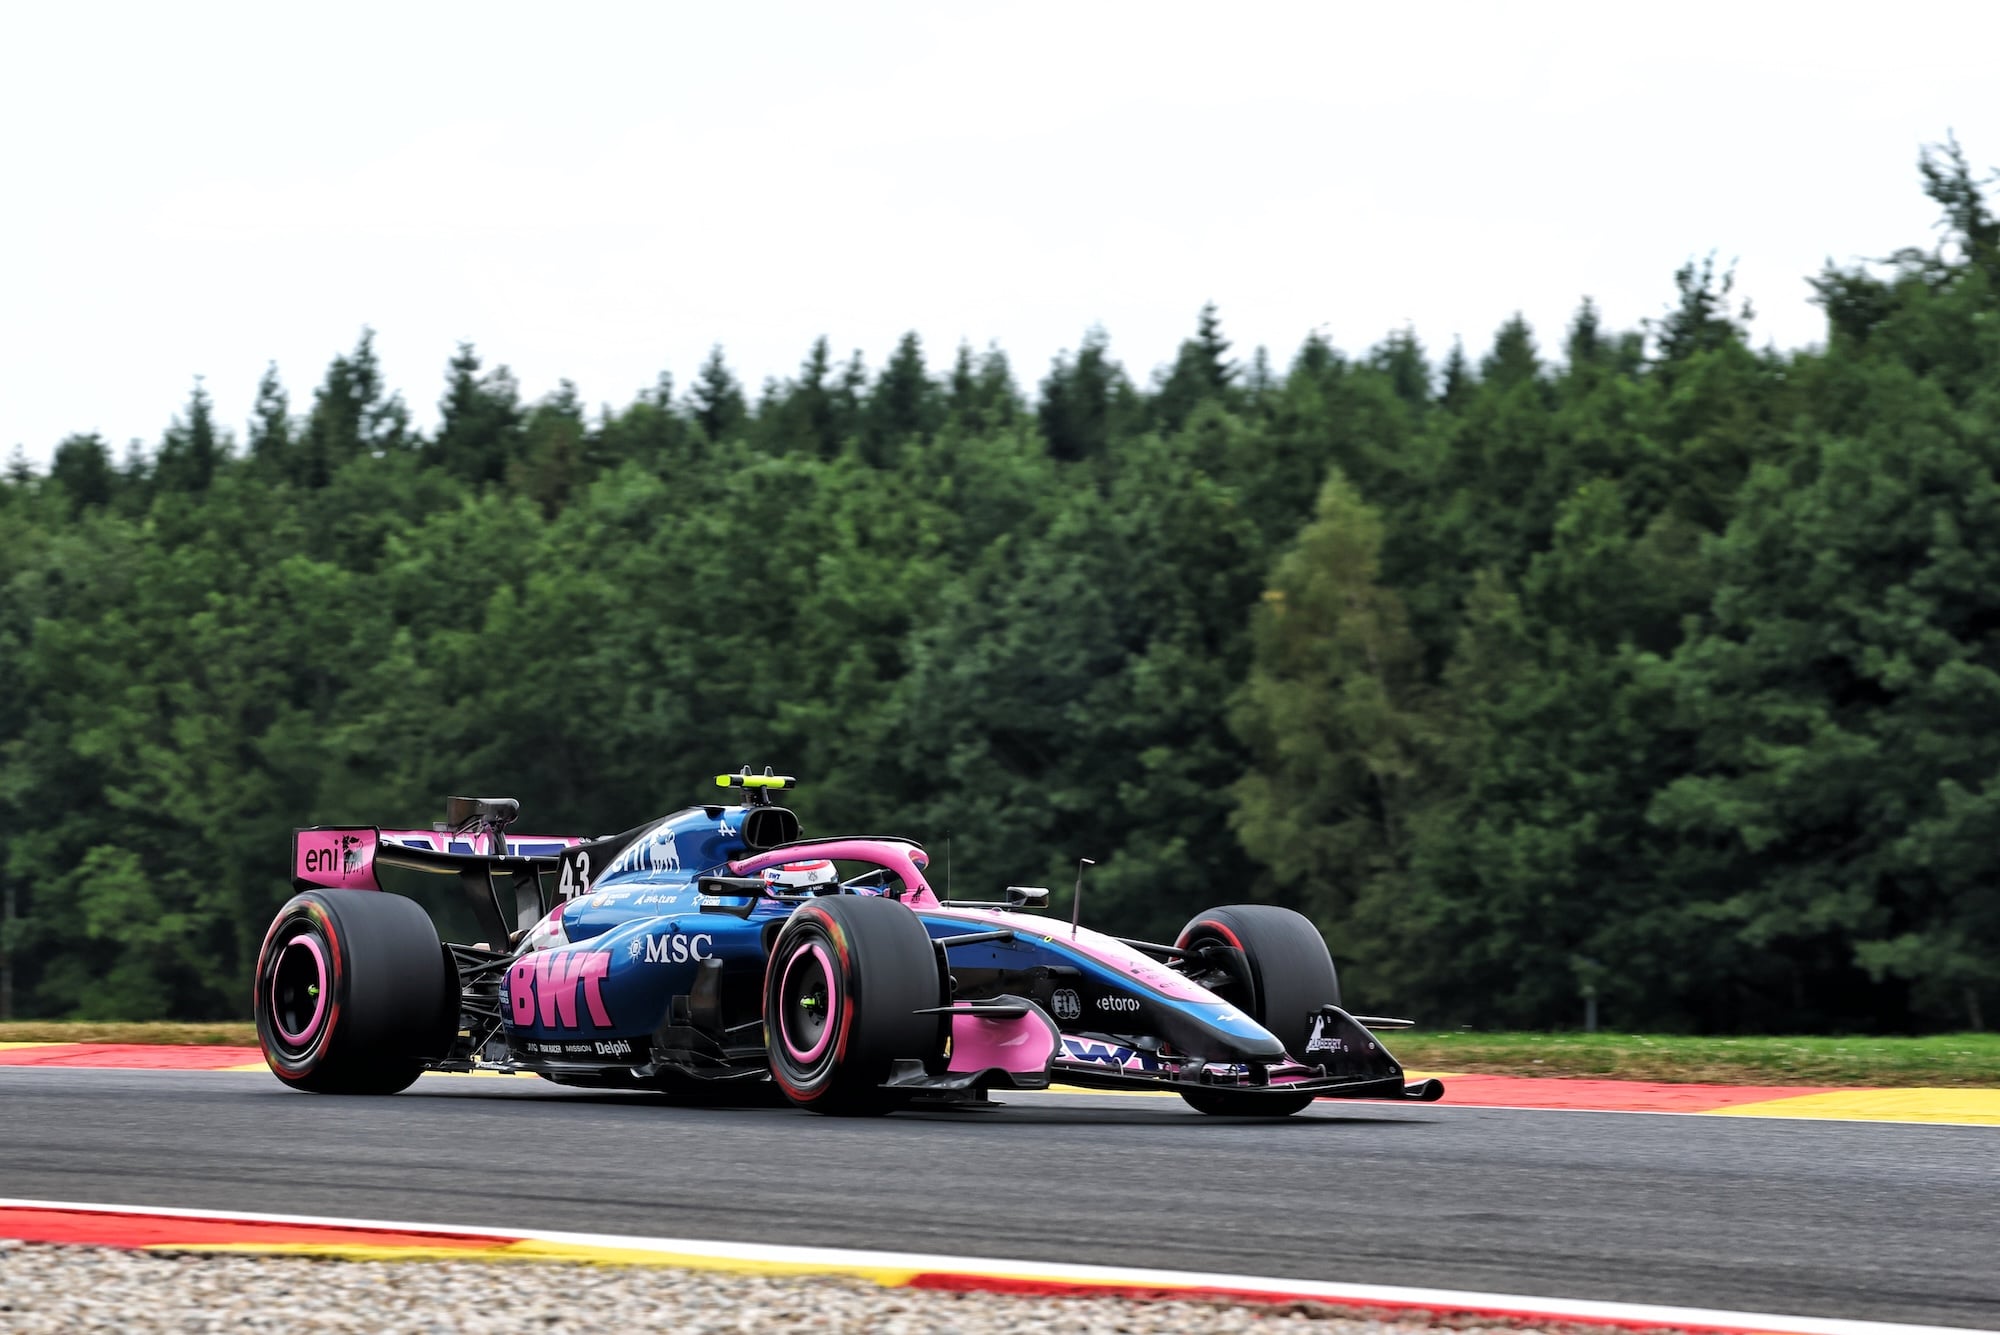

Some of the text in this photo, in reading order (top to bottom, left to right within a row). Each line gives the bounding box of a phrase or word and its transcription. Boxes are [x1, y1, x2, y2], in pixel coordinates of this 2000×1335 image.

[305, 839, 338, 872] eni
[559, 851, 590, 901] 43
[644, 934, 713, 963] MSC
[510, 952, 613, 1028] BWT
[565, 1045, 592, 1053] MISSION
[595, 1039, 631, 1056] Delphi
